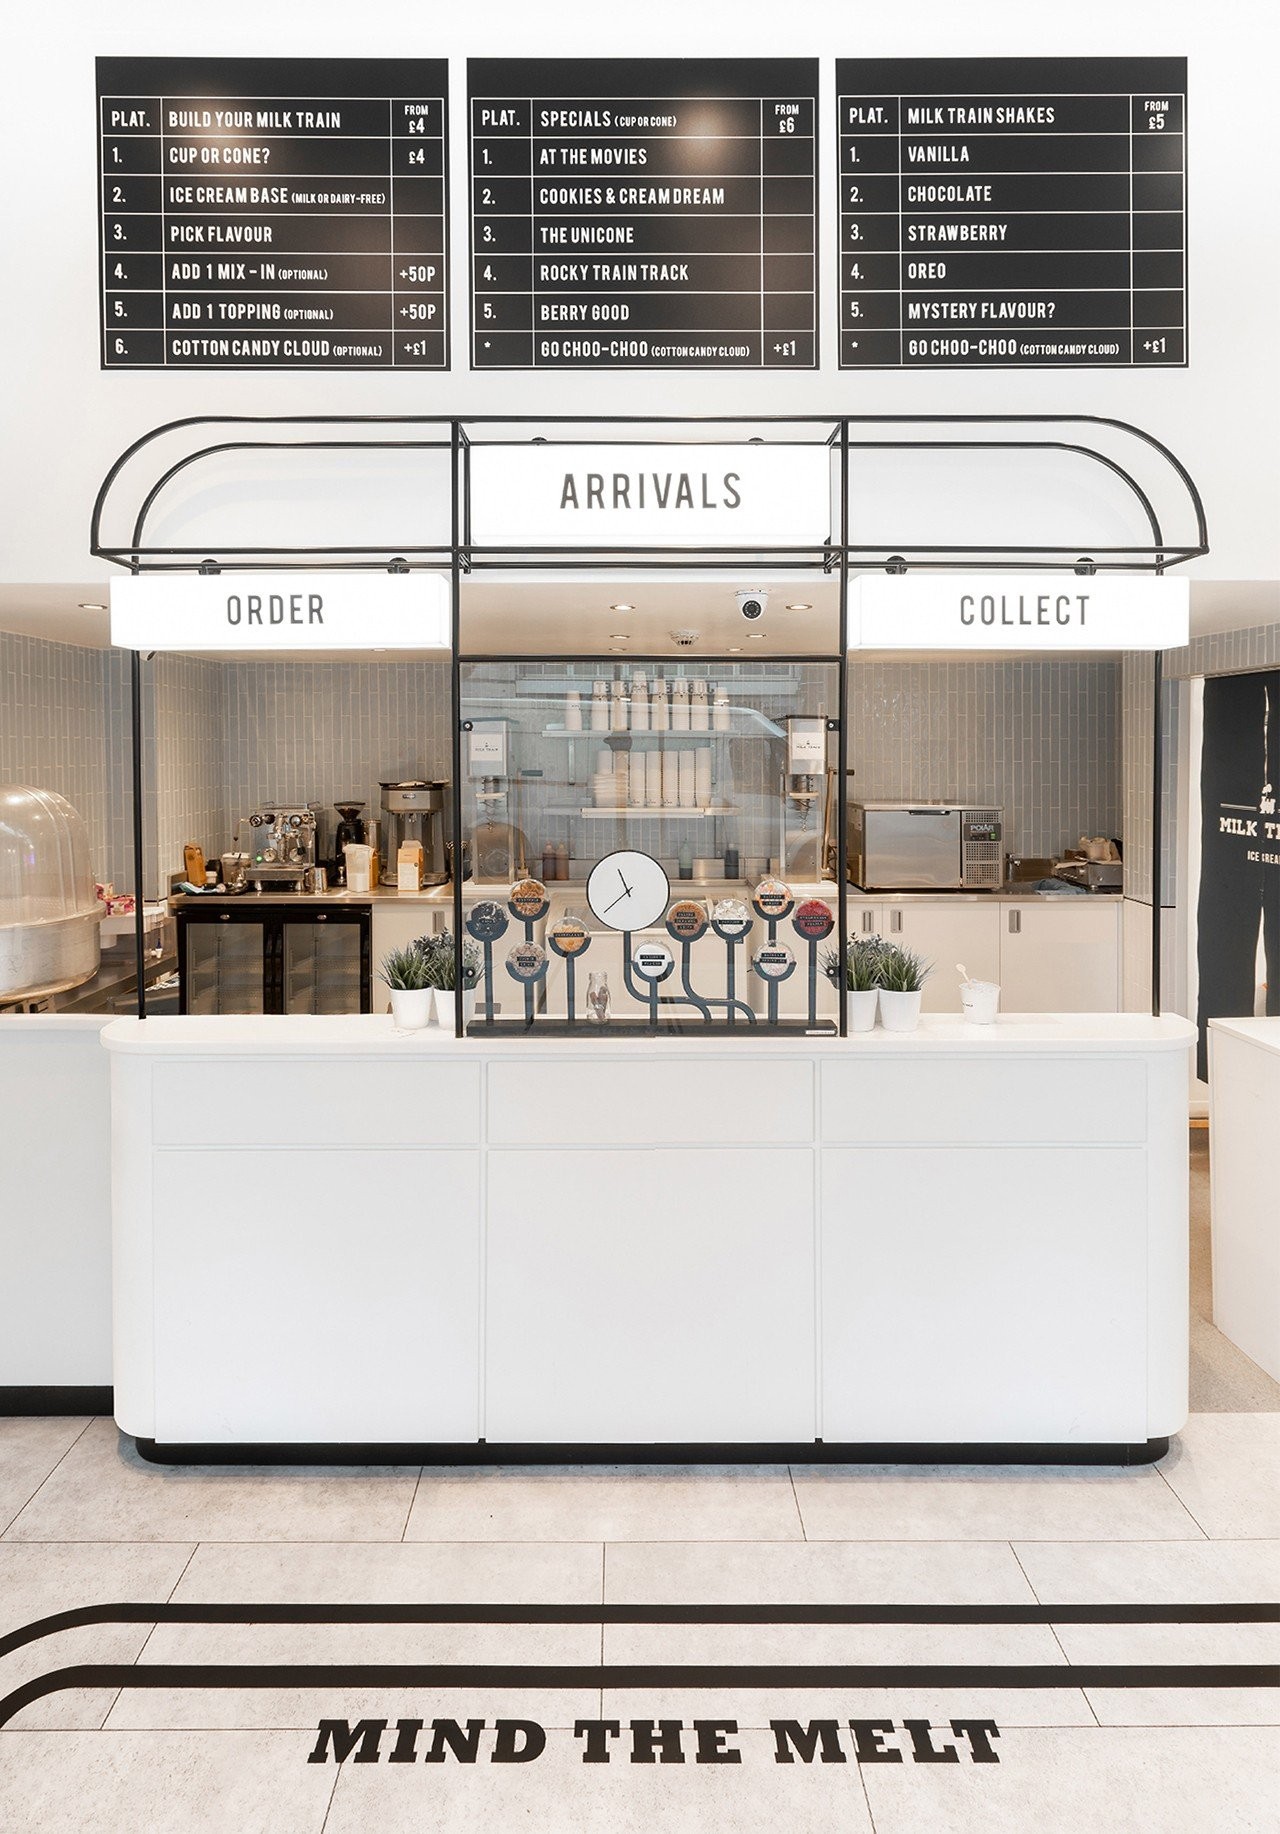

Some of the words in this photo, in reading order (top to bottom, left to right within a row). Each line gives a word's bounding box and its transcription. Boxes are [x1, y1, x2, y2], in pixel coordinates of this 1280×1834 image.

[405, 105, 428, 115] FROM
[775, 105, 799, 115] FROM
[1145, 101, 1168, 111] FROM
[112, 111, 150, 127] PLAT.
[169, 111, 212, 129] BUILD
[214, 111, 252, 130] YOUR
[257, 112, 292, 127] MILK
[296, 112, 340, 128] TRAIN
[482, 110, 520, 125] PLAT.
[541, 111, 611, 127] SPECIALS
[638, 117, 651, 126] OR
[850, 108, 888, 123] PLAT.
[908, 108, 943, 124] MILK
[948, 108, 992, 123] TRAIN
[996, 107, 1054, 123] SHAKES
[1149, 114, 1164, 129] £5
[409, 118, 425, 133] £4
[780, 117, 794, 133] £6
[113, 147, 122, 162] 1.
[170, 146, 197, 163] CUP
[201, 147, 221, 163] OR
[221, 146, 270, 164] CONE?
[409, 149, 425, 164] £4
[483, 149, 492, 164] 1.
[540, 149, 556, 164] AT
[561, 149, 587, 164] THE
[591, 149, 646, 164] MOVIES
[850, 147, 859, 162] 1.
[908, 146, 969, 162] VANILLA
[113, 187, 126, 202] 2.
[170, 187, 193, 203] ICE
[197, 187, 247, 203] CREAM
[250, 187, 288, 203] BASE
[318, 194, 329, 203] OR
[483, 189, 495, 204] 2.
[540, 188, 602, 204] COOKIES
[606, 188, 615, 204] &
[620, 188, 670, 204] CREAM
[674, 188, 724, 204] DREAM
[851, 187, 863, 202] 2.
[908, 186, 991, 202] CHOCOLATE
[114, 224, 126, 240] 3.
[171, 226, 204, 242] PICK
[208, 226, 272, 242] FLAVOUR
[483, 226, 495, 242] 3.
[541, 227, 567, 243] THE
[571, 227, 633, 243] UNICONE
[851, 224, 863, 240] 3.
[909, 225, 1007, 241] STRAWBERRY
[115, 263, 127, 279] 4.
[172, 264, 200, 279] ADD
[207, 264, 212, 279] 1
[218, 264, 245, 279] MIX
[261, 264, 274, 279] IN
[278, 269, 328, 280] (OPTIONAL)
[400, 266, 435, 282] +50P
[484, 265, 496, 280] 4.
[541, 265, 588, 281] ROCKY
[593, 265, 636, 280] TRAIN
[641, 265, 688, 280] TRACK
[851, 263, 864, 279] 4.
[909, 263, 945, 279] OREO
[115, 301, 127, 317] 5.
[173, 303, 200, 319] ADD
[207, 304, 212, 319] 1
[219, 304, 280, 319] TOPPING
[284, 309, 333, 319] (OPTIONAL)
[400, 304, 435, 319] +50P
[484, 303, 496, 318] 5.
[541, 305, 587, 320] BERRY
[592, 305, 629, 320] GOOD
[851, 302, 863, 317] 5.
[909, 303, 977, 319] MYSTERY
[982, 302, 1055, 318] FLAVOUR?
[116, 338, 128, 354] 6.
[173, 340, 228, 355] COTTON
[232, 340, 280, 356] CANDY
[284, 340, 329, 356] CLOUD
[333, 346, 382, 356] (OPTIONAL)
[404, 340, 425, 355] +£1
[542, 341, 559, 357] GO
[563, 341, 647, 357] CHOO-CHOO
[774, 341, 795, 355] +£1
[909, 340, 927, 355] GO
[931, 339, 1016, 355] CHOO-CHOO
[1143, 338, 1165, 353] +£1
[560, 473, 740, 509] ARRIVALS
[227, 594, 323, 625] ORDER
[961, 595, 1089, 625] COLLECT
[1220, 817, 1258, 837] MILK
[1247, 850, 1260, 862] ICE
[308, 1719, 545, 1763] MIND
[575, 1720, 741, 1763] THE
[770, 1720, 999, 1763] MELT
